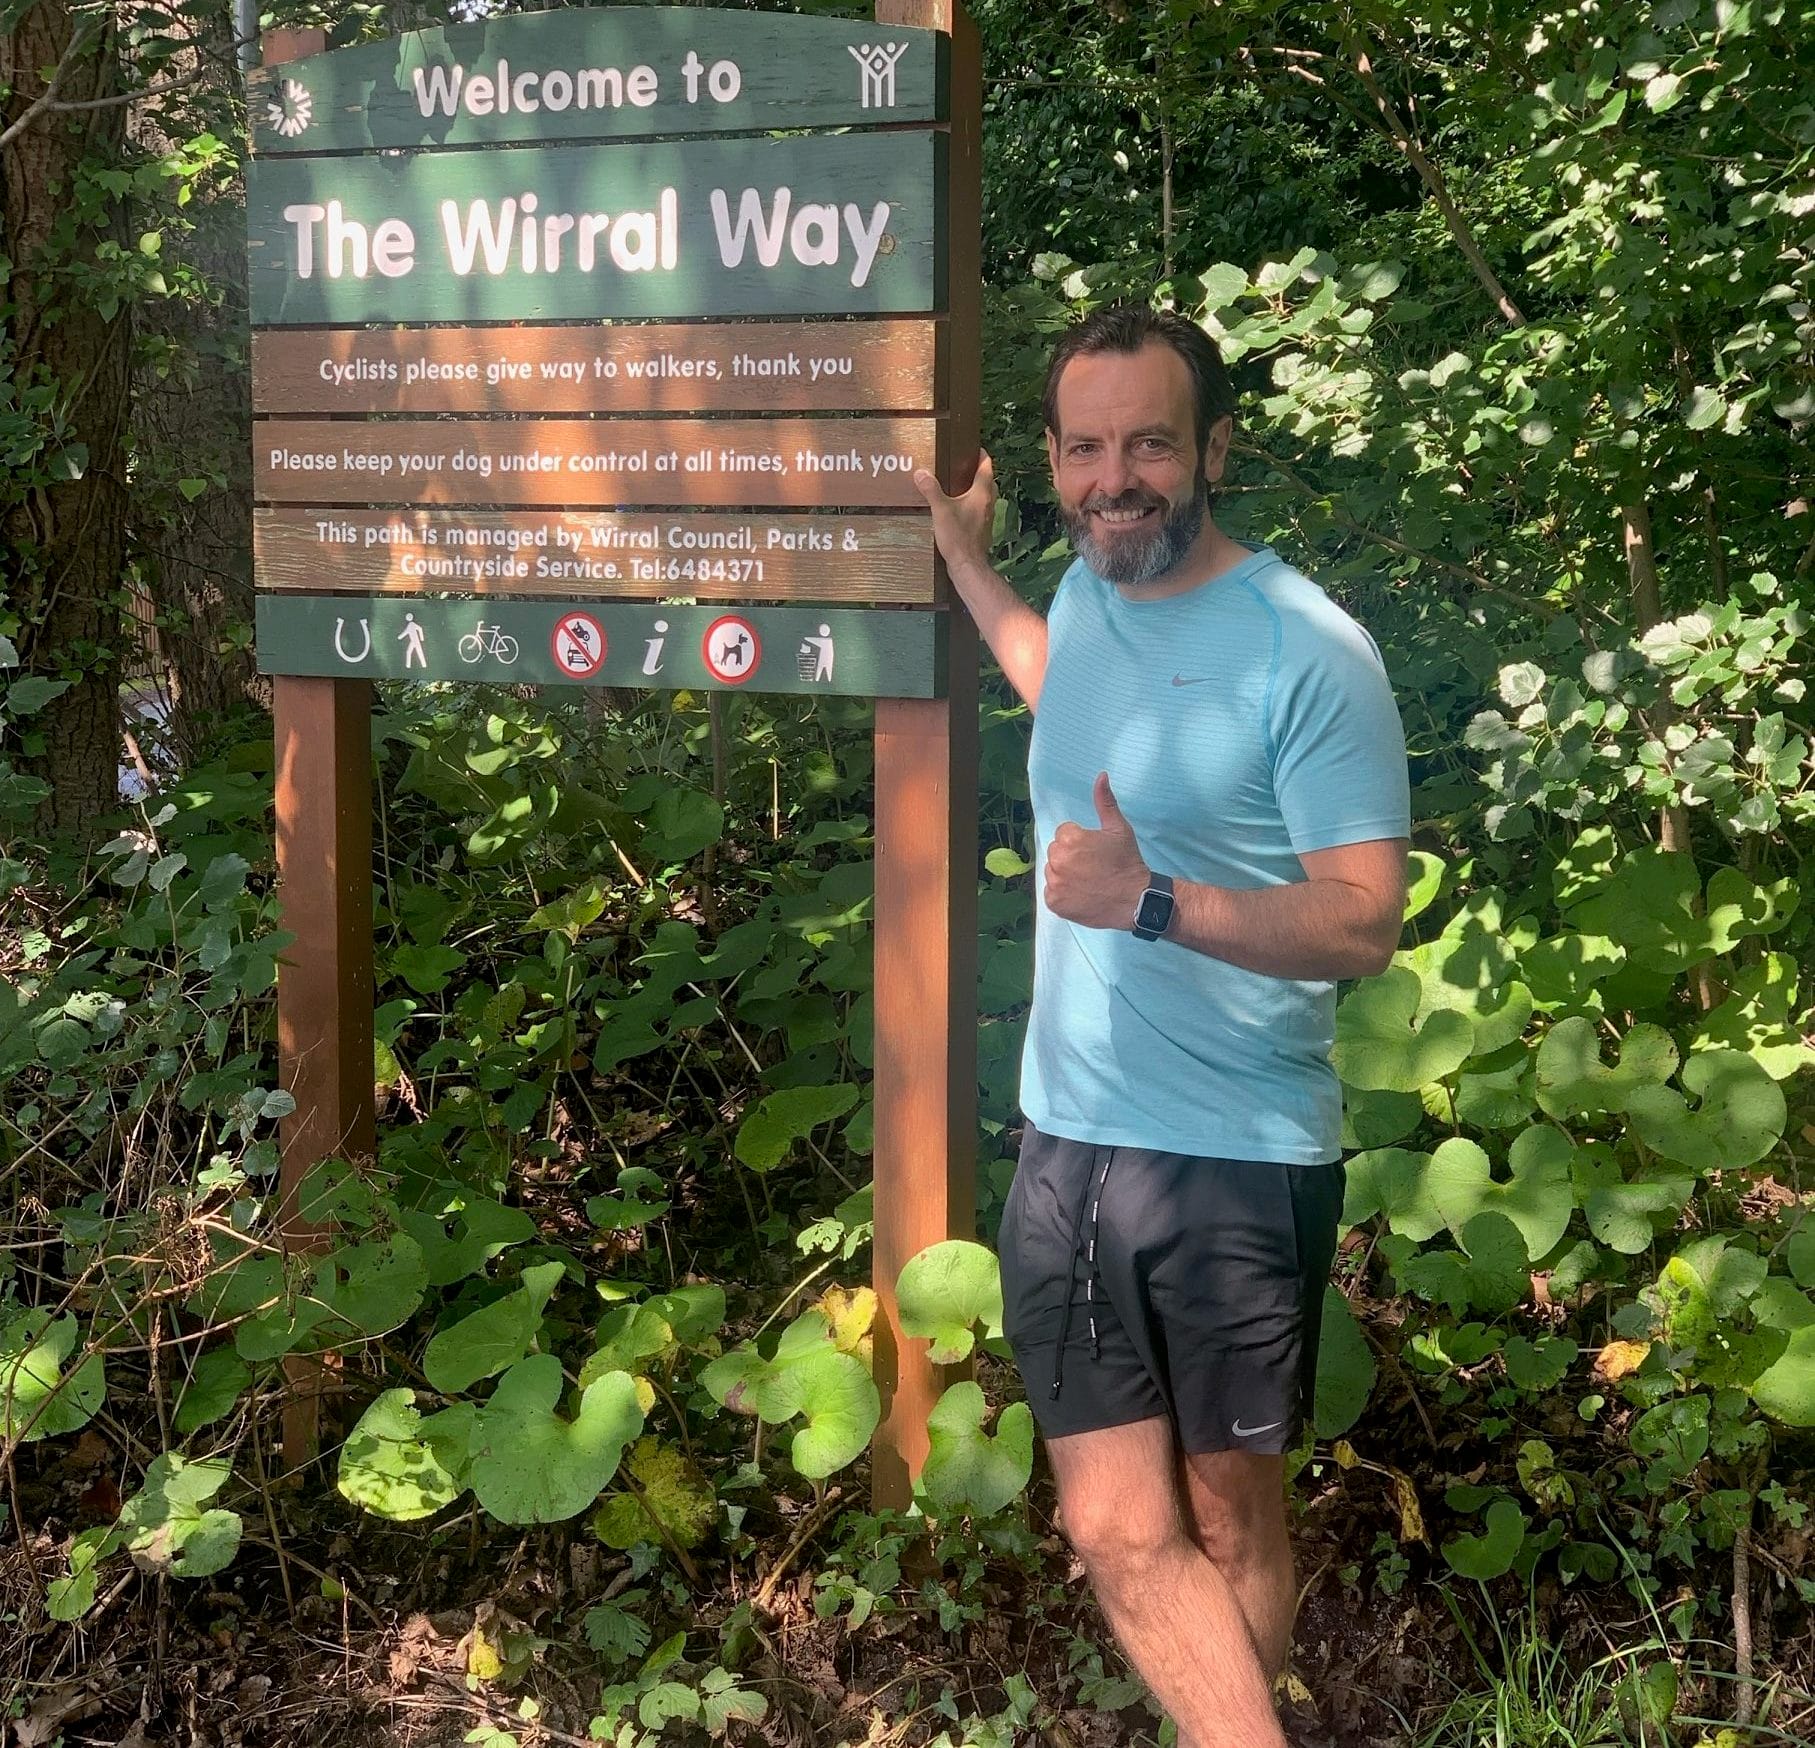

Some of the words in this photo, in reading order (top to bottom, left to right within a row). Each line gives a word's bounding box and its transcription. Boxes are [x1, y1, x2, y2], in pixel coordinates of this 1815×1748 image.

[413, 58, 659, 119] Welcome
[681, 50, 742, 104] to
[284, 199, 415, 280] The
[441, 186, 678, 276] Wirral
[710, 185, 892, 289] Way
[319, 358, 398, 385] Cyclists
[406, 357, 479, 384] please
[486, 357, 533, 385] give
[540, 360, 587, 384] way
[594, 356, 618, 378] to
[626, 353, 723, 381] walkers,
[732, 352, 801, 376] thank
[809, 357, 853, 381] you
[270, 449, 337, 470] Please
[343, 449, 393, 475] keep
[400, 453, 446, 476] your
[451, 449, 492, 477] dog
[499, 450, 562, 472] under
[567, 449, 648, 473] control
[655, 452, 678, 472] at
[684, 450, 713, 472] all
[719, 450, 788, 476] times,
[795, 450, 864, 473] thank
[870, 454, 913, 477] you
[316, 522, 357, 544] This
[364, 523, 414, 548] path
[421, 524, 438, 544] is
[445, 528, 548, 551] managed
[556, 527, 583, 552] by
[591, 527, 659, 549] Wirral
[667, 527, 758, 553] Council,
[766, 528, 834, 551] Parks
[841, 529, 859, 551] &
[401, 555, 529, 582] Countryside
[536, 557, 623, 580] Service.
[629, 558, 765, 582] Tel:6484371
